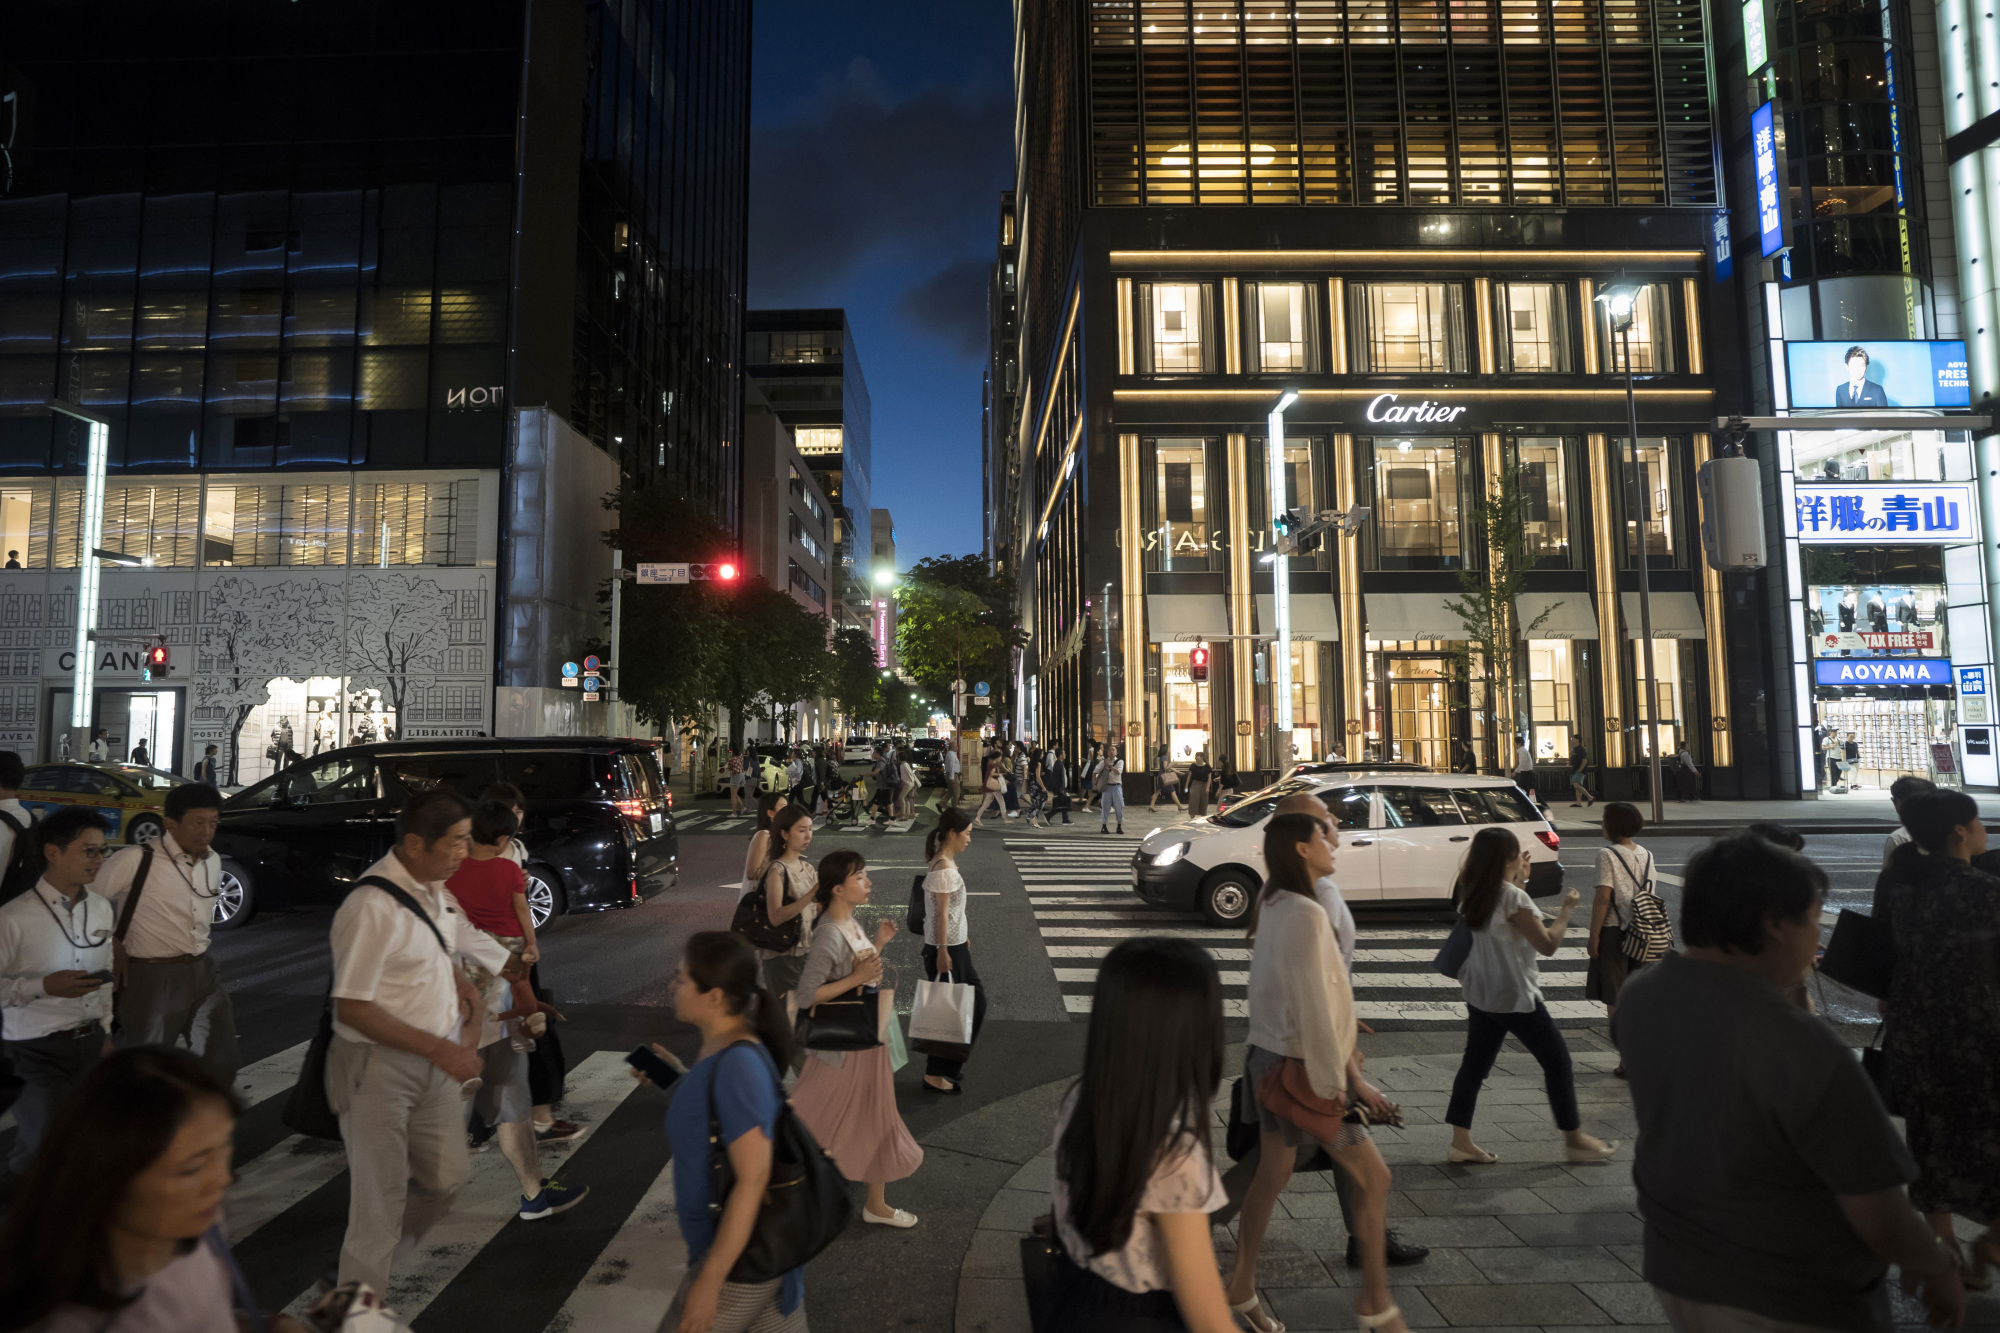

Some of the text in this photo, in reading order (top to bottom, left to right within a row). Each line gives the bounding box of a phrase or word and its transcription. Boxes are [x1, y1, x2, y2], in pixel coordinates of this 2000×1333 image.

[1756, 126, 1778, 235] 洋服の青山
[1366, 393, 1466, 423] Cartier
[1796, 494, 1960, 532] 洋服の青山
[640, 568, 686, 578] 銀座二丁目
[1415, 631, 1446, 641] Cartier
[1544, 630, 1575, 640] Cartier
[1652, 629, 1682, 639] Cartier
[1863, 633, 1915, 648] TAX FREE
[1397, 664, 1433, 675] Cartier
[1840, 664, 1931, 680] AOYAMA
[407, 729, 479, 737] LIBRAIRIE
